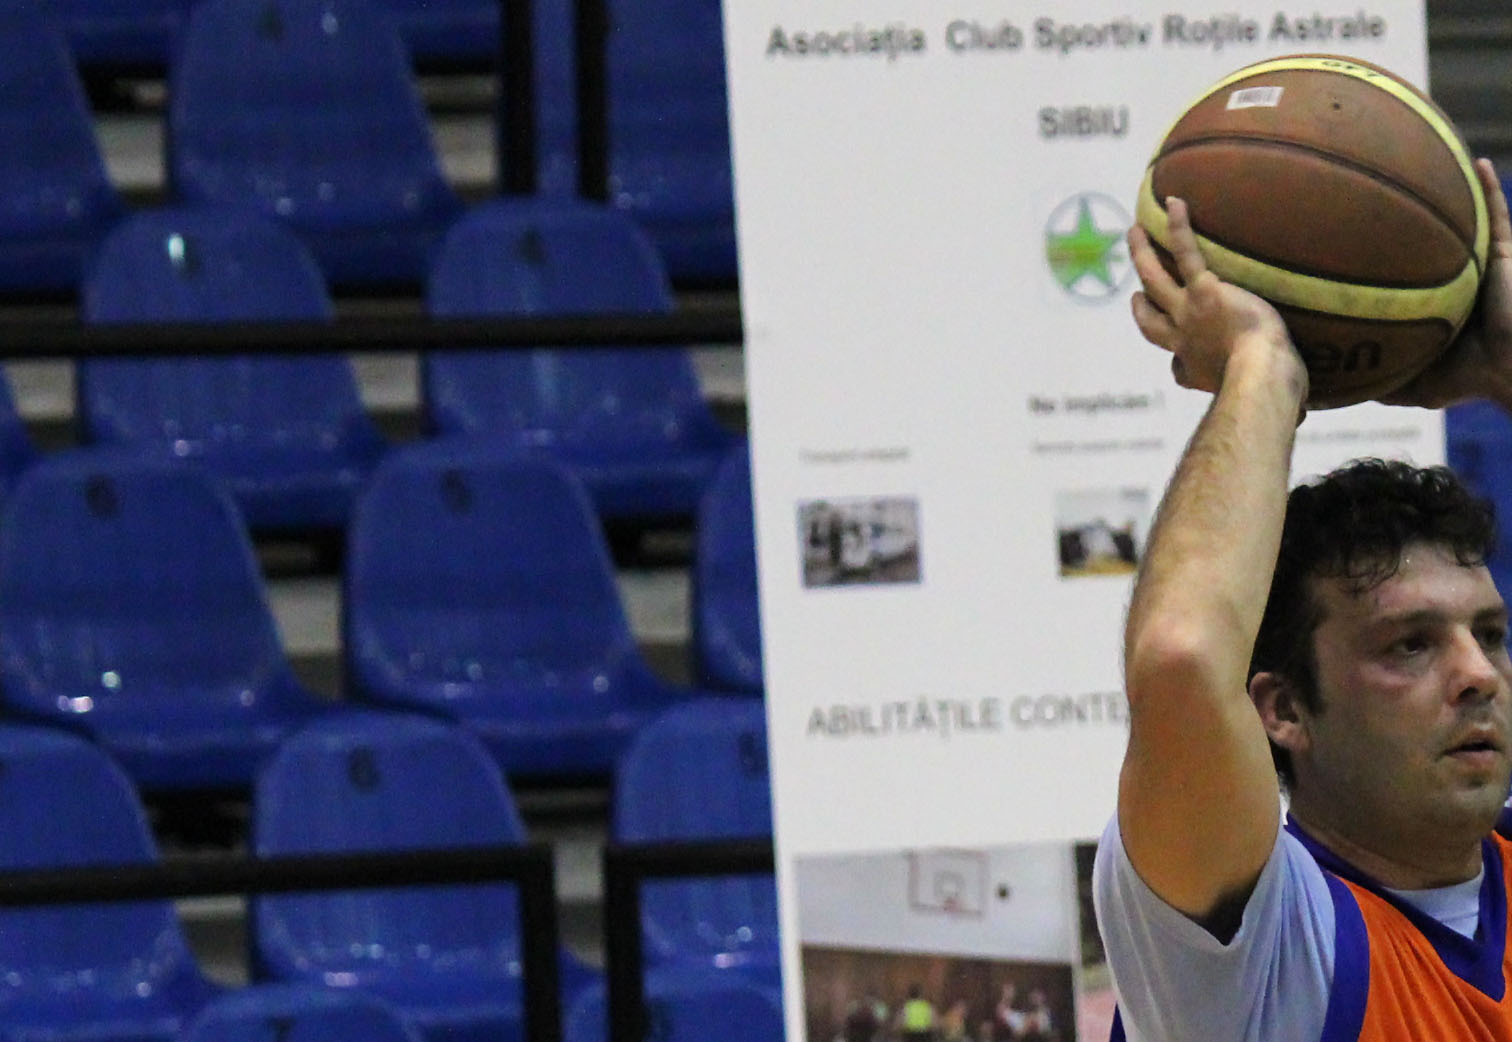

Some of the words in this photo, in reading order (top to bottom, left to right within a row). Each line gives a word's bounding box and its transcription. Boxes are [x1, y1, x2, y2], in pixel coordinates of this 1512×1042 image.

[946, 19, 1023, 50] Club
[1035, 15, 1152, 55] Sportiv
[1268, 9, 1387, 41] Astrale
[1037, 105, 1130, 139] SIBIU
